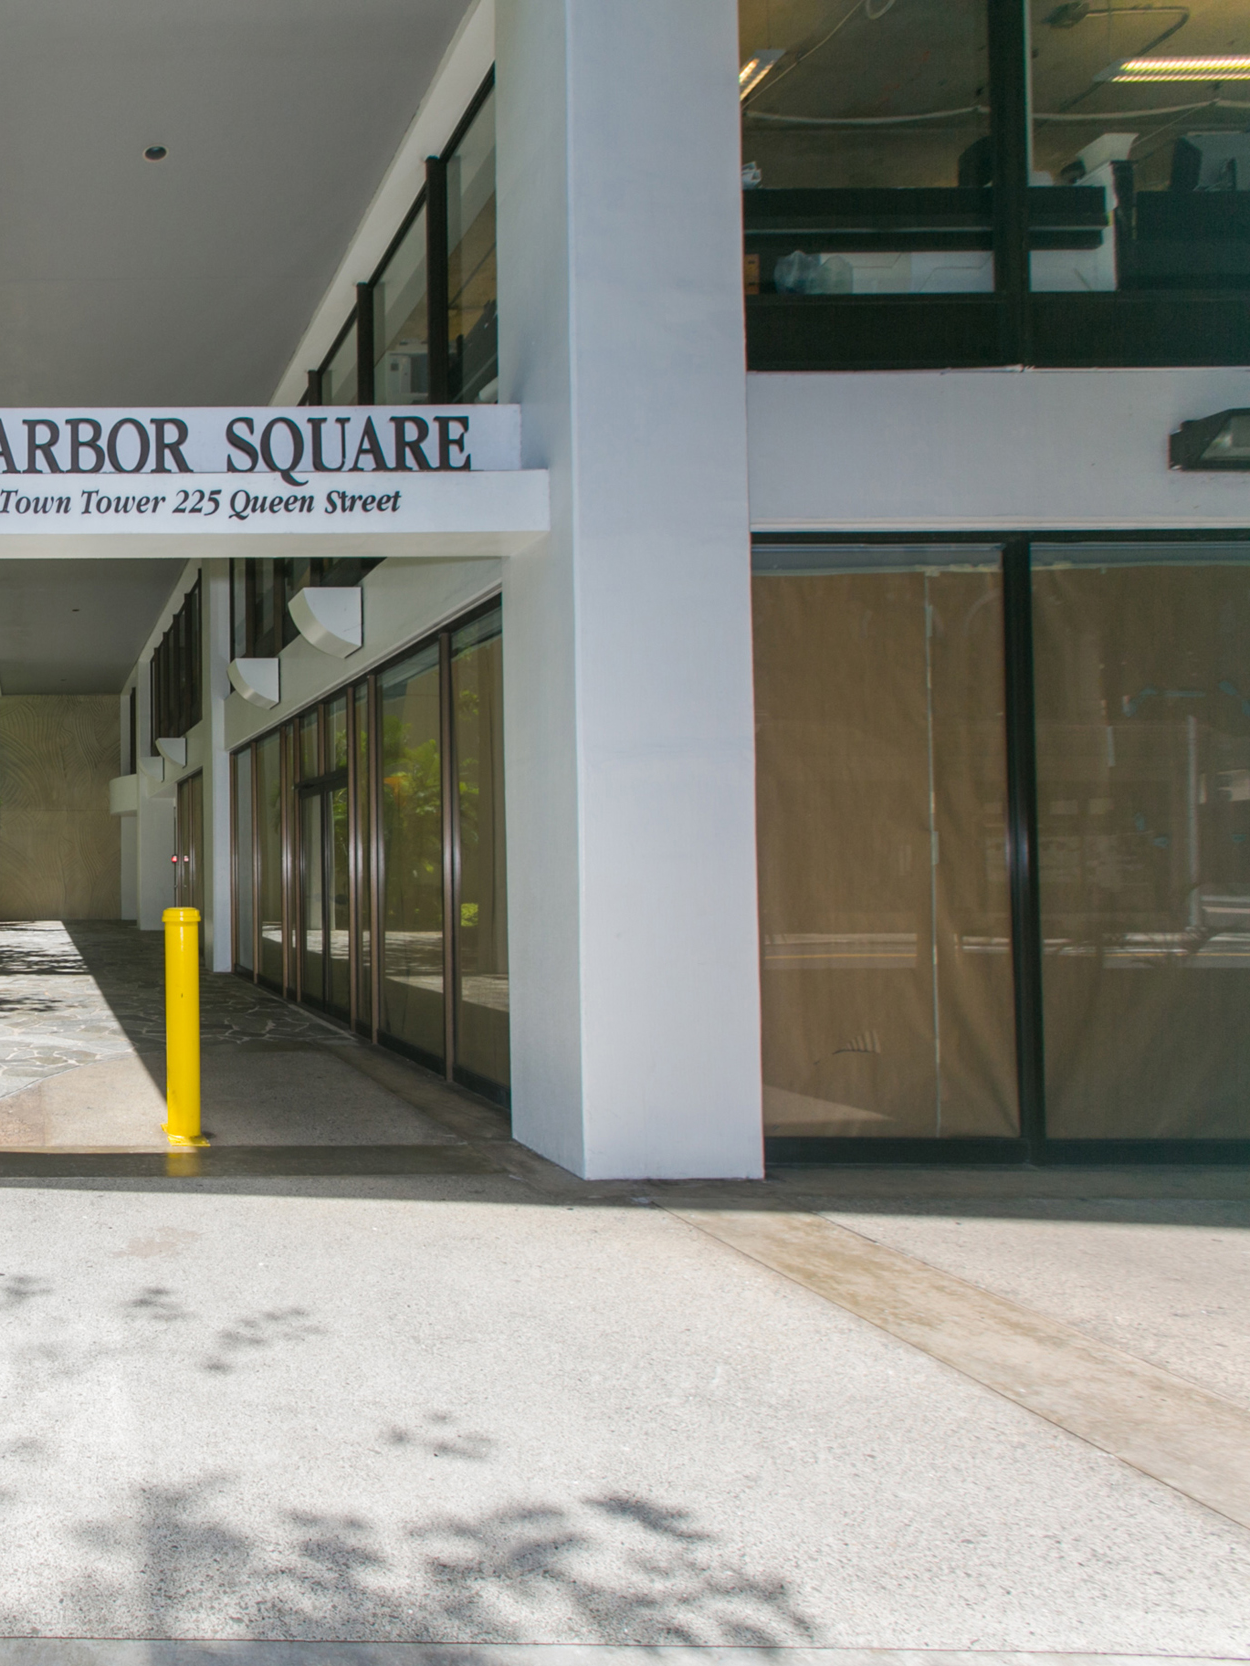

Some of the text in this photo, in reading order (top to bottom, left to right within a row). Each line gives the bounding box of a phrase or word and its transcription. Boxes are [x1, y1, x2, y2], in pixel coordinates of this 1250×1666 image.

[226, 414, 473, 486] SQUARE
[0, 489, 403, 522] Town Tower 225 Queen Street
